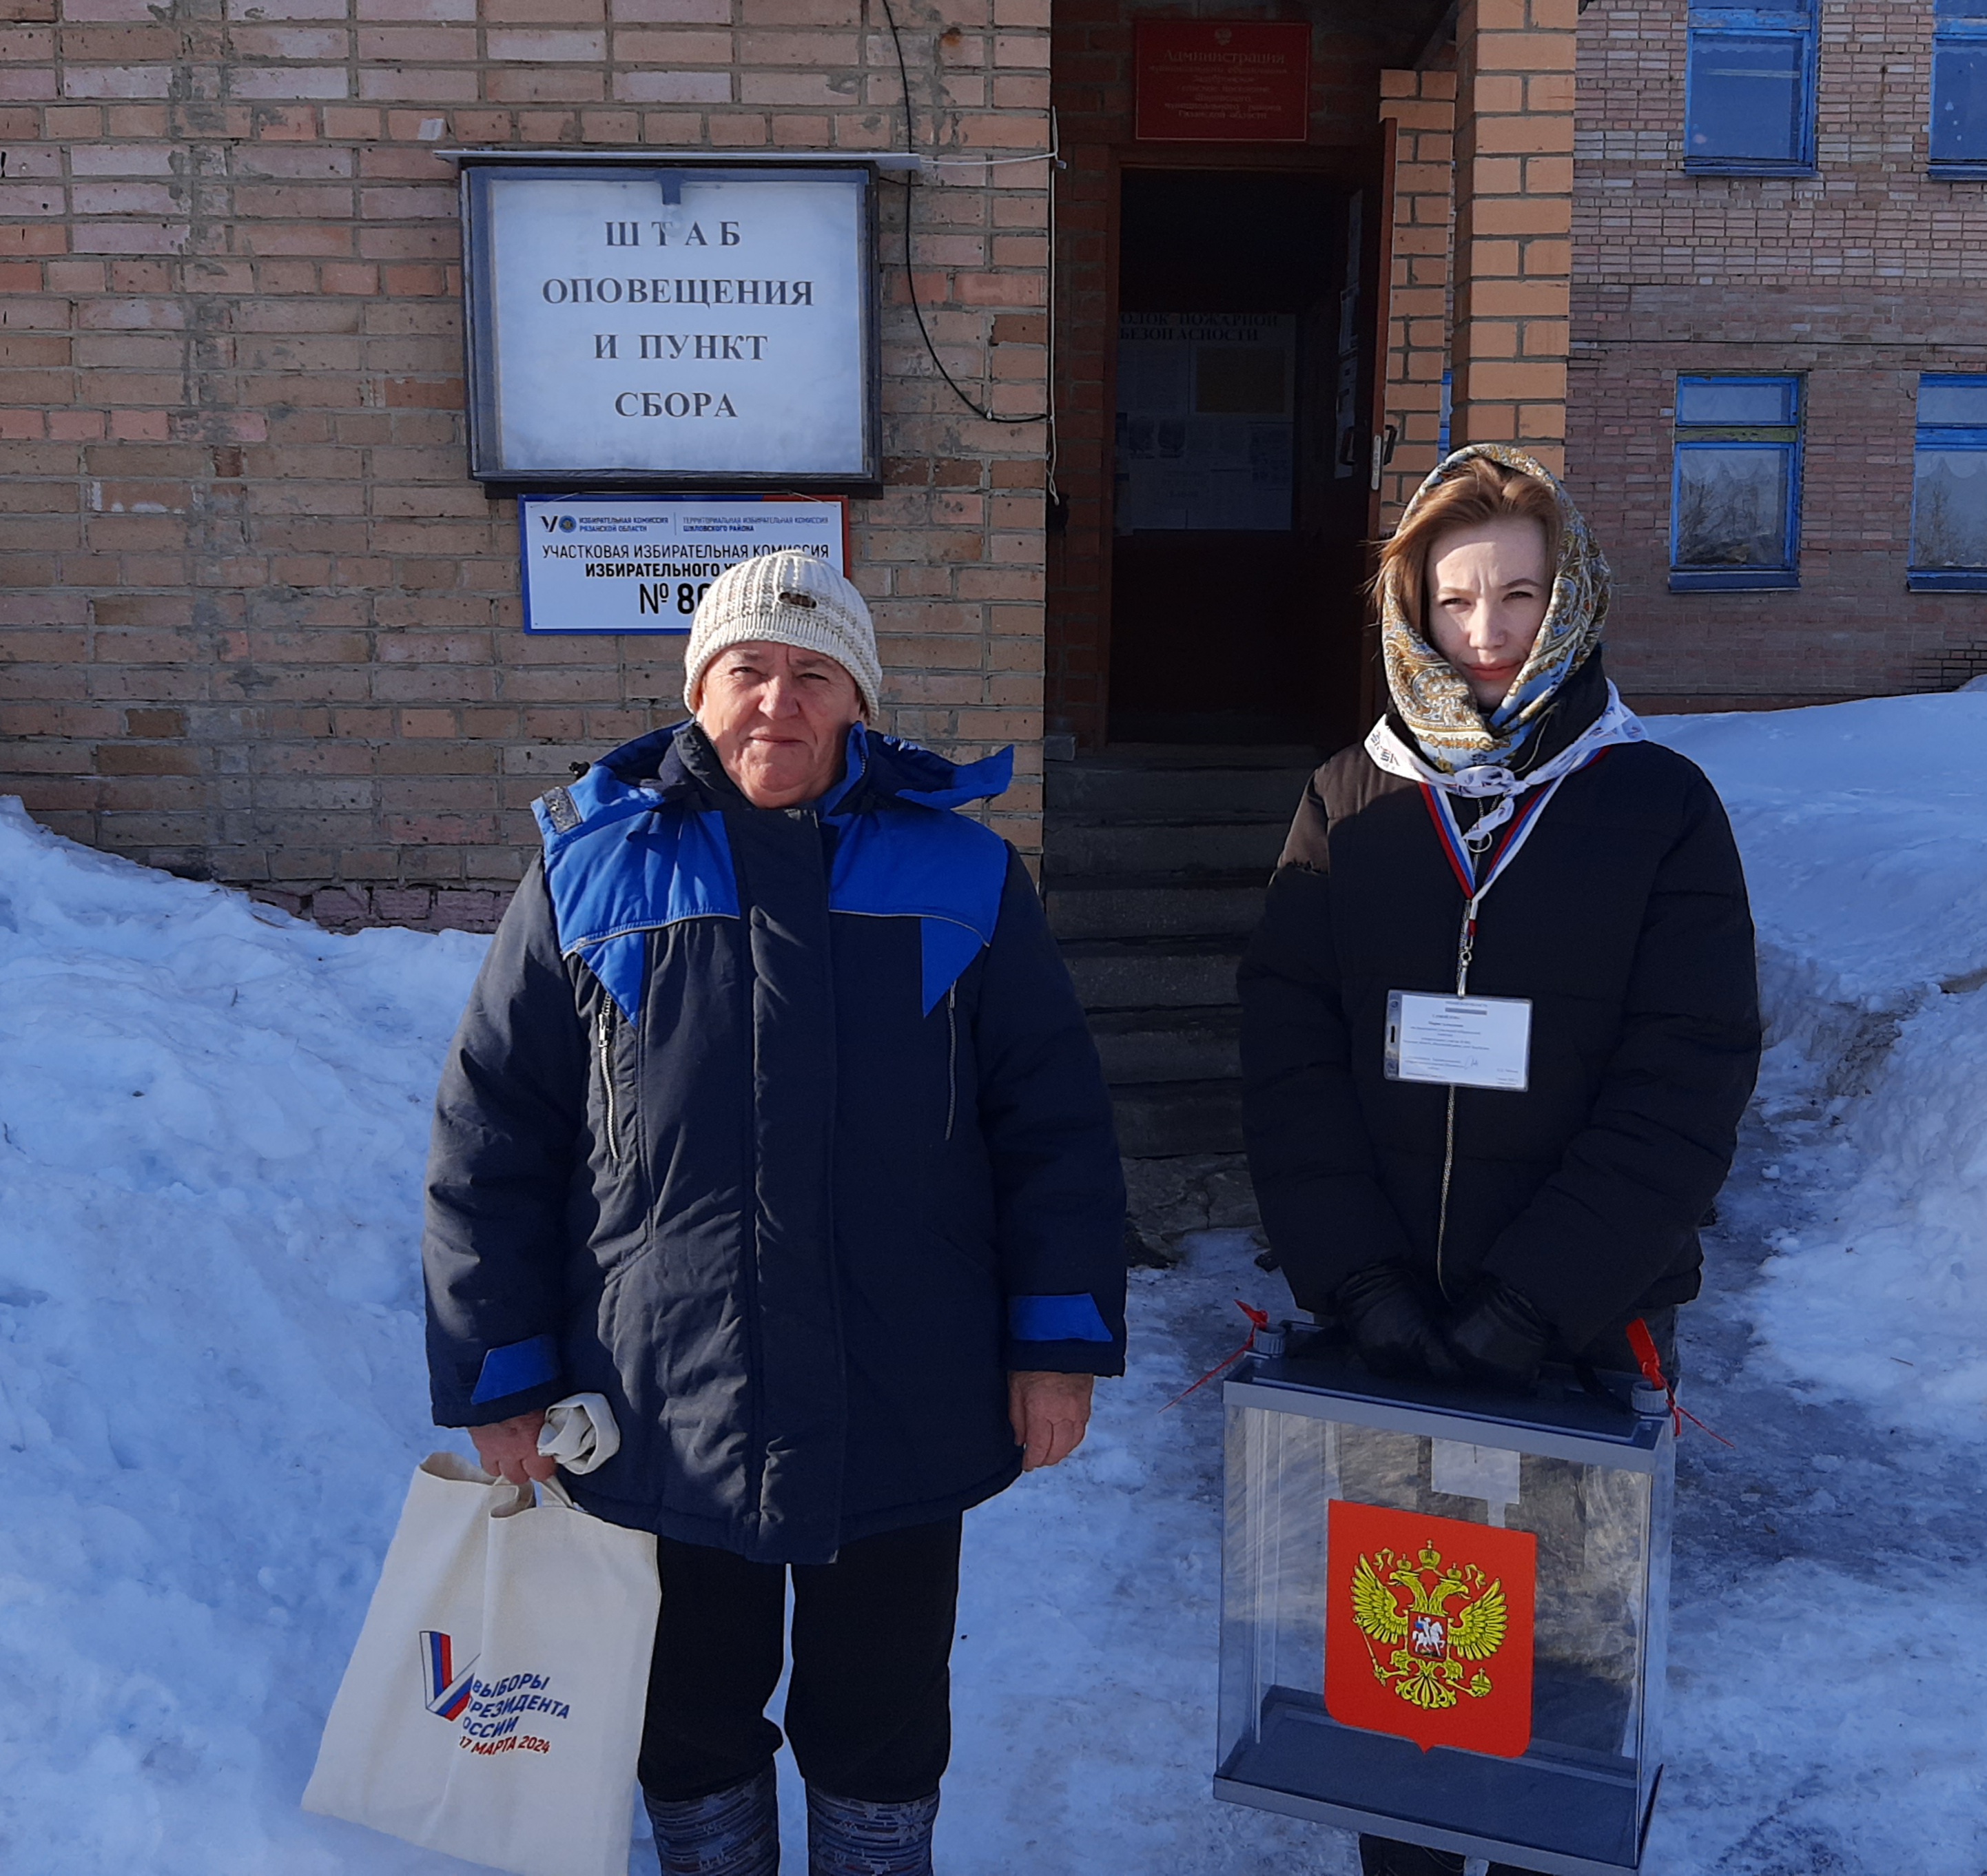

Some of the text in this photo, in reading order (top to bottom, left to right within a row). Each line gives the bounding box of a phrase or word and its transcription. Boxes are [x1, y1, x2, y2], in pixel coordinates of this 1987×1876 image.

[1164, 50, 1285, 64] Администрация
[605, 221, 741, 246] ШТАБ
[542, 278, 814, 309] ОПОВЕЩЕНИЯ
[594, 334, 768, 360] И ПУНКТ
[615, 391, 738, 418] СБОРА
[729, 524, 754, 533] РАЙОНА
[542, 544, 629, 559] УЧАСТКОВАЯ
[634, 544, 749, 559] ИЗБИРАТЕЛЬНАЯ
[586, 563, 720, 577] ИЗБИРАТЕЛЬНОГО
[639, 583, 669, 615] №
[472, 1673, 550, 1698] ВЫБОРЫ
[471, 1735, 517, 1755] МАРТА
[518, 1735, 550, 1754] 2024
